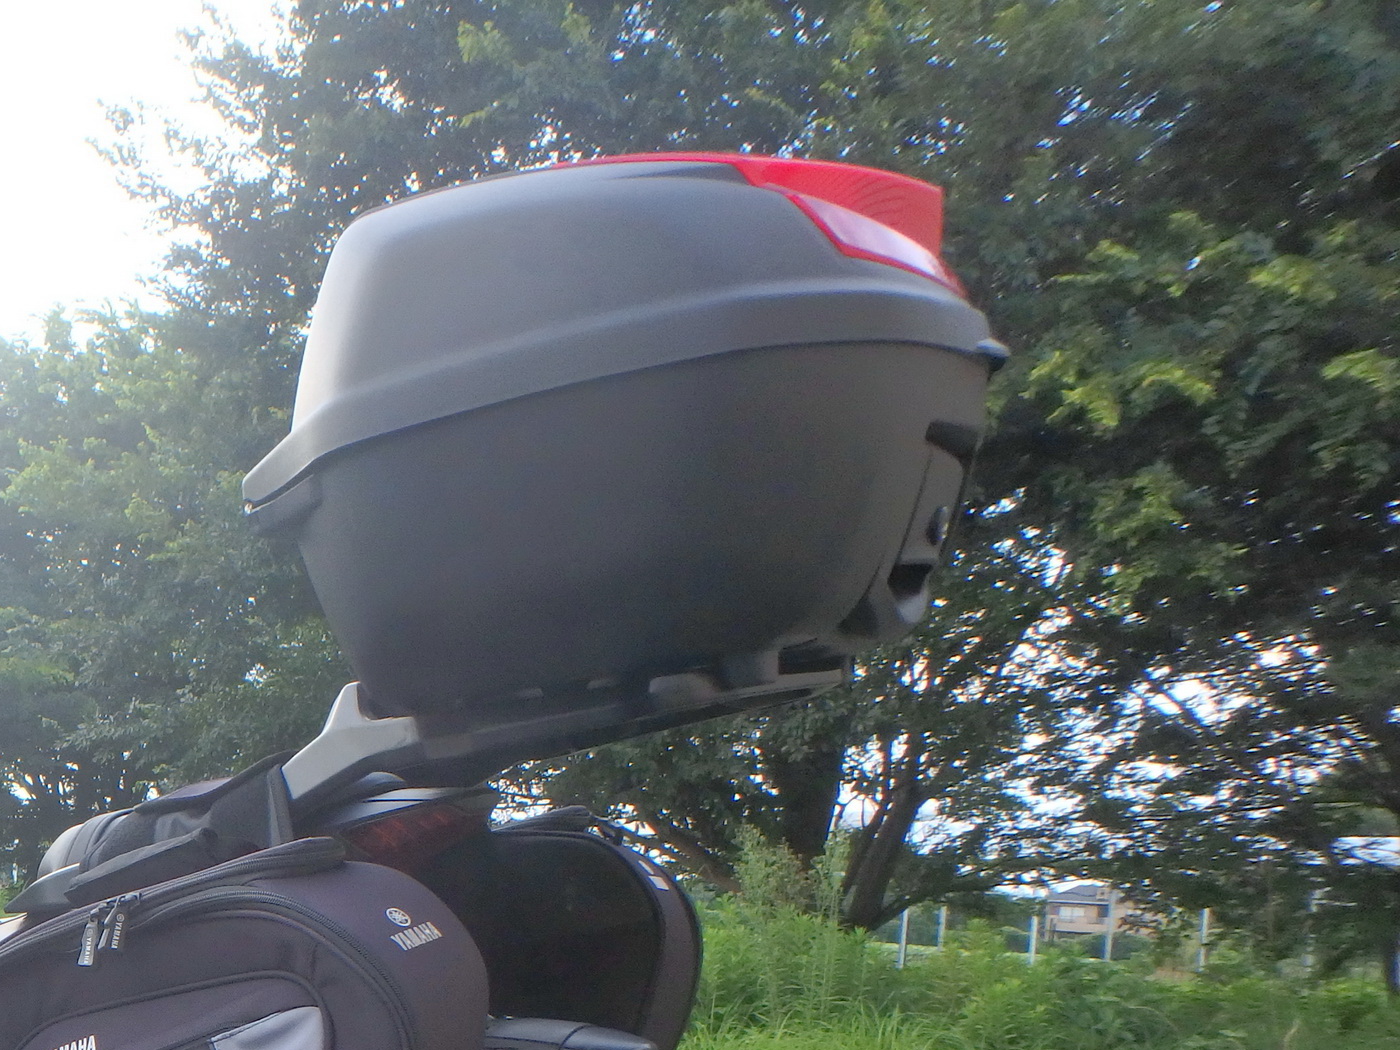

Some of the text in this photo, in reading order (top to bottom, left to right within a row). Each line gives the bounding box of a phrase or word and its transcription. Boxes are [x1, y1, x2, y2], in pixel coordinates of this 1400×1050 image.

[111, 922, 123, 948] YAMAHA
[390, 922, 442, 951] YAMAHA
[84, 937, 92, 963] YAMAHA
